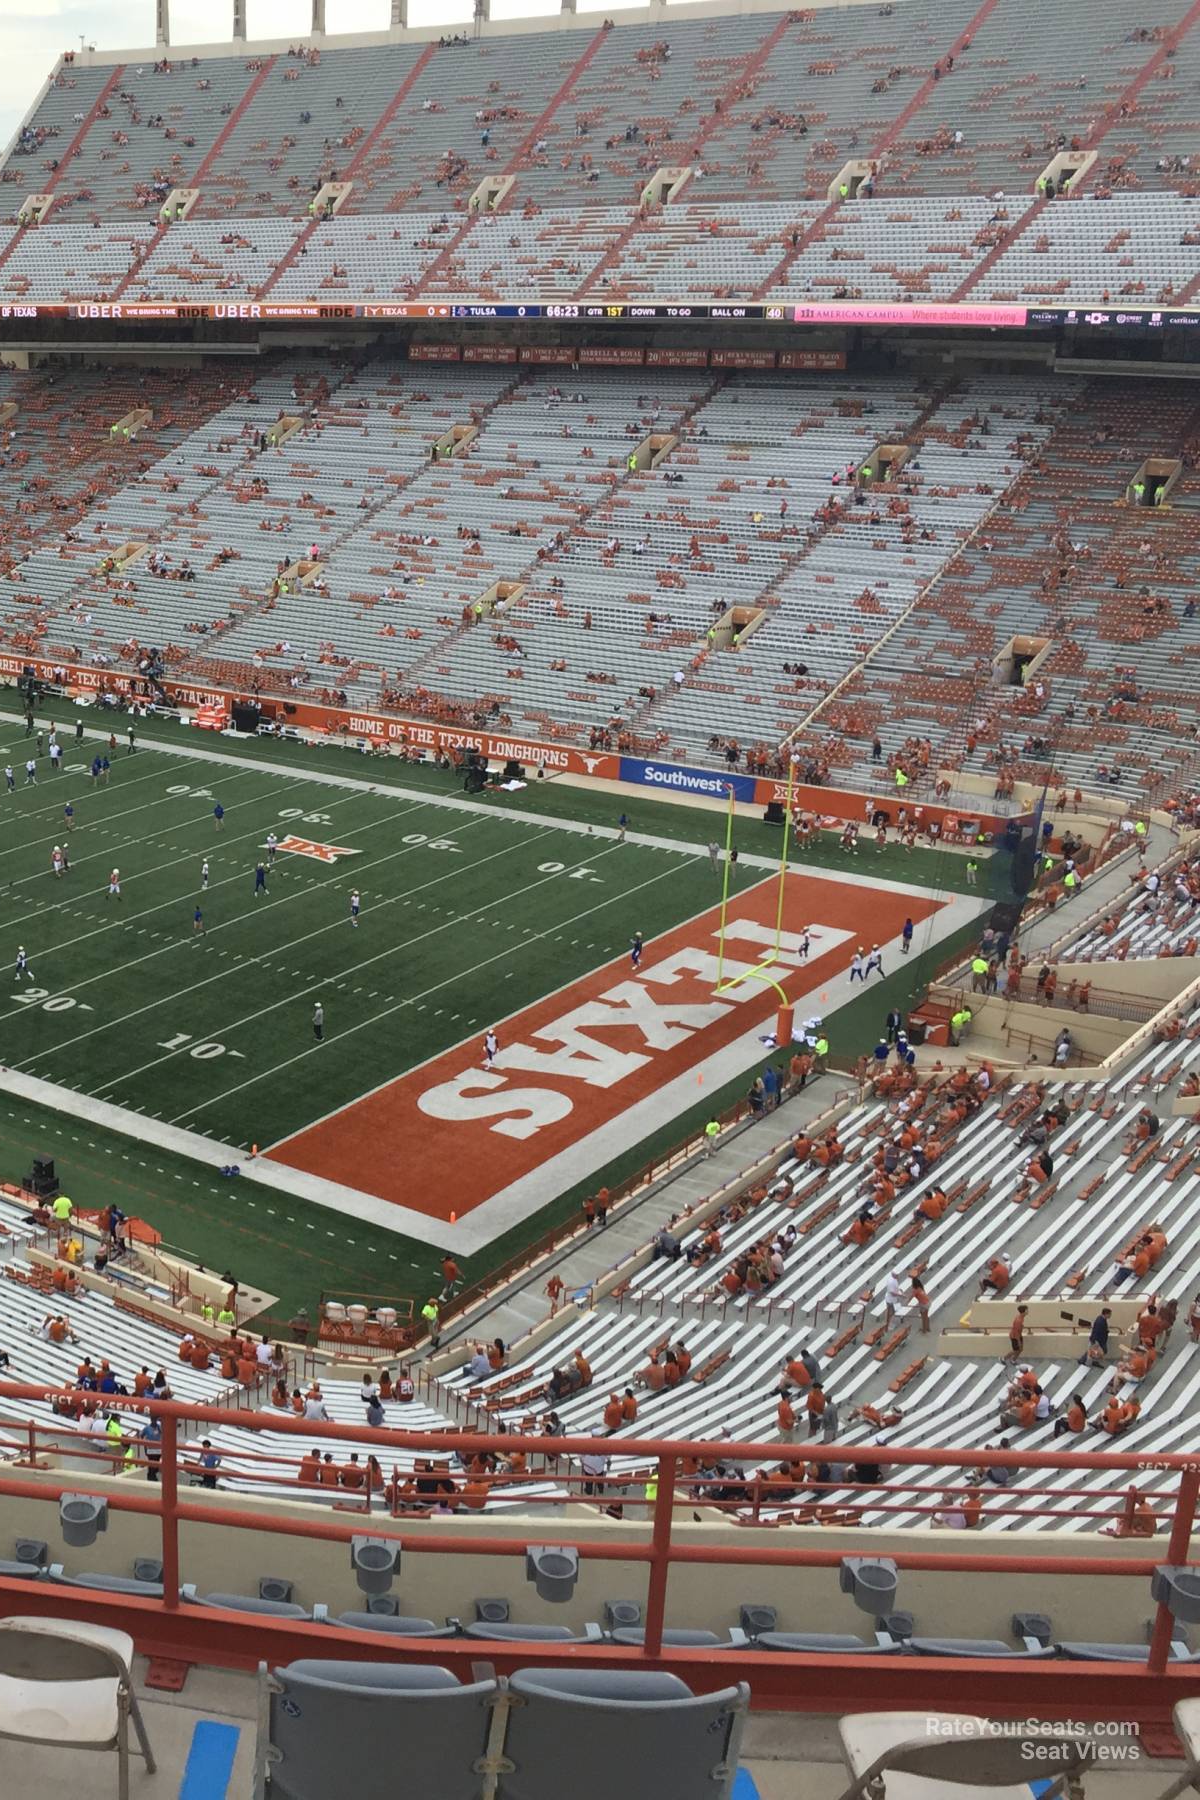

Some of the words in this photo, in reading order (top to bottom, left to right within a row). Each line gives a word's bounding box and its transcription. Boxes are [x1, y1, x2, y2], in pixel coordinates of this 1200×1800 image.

[2, 307, 11, 317] OF
[13, 307, 37, 317] TEXAS
[77, 305, 122, 318] UBER
[177, 308, 209, 317] RIDE
[215, 305, 261, 318] UBER
[319, 308, 352, 317] RIDE
[428, 307, 435, 315] 0
[518, 307, 525, 316] 0
[546, 306, 579, 316] 66:23
[587, 308, 603, 316] QTR
[606, 307, 623, 316] 1ST
[712, 308, 731, 316] BALL
[767, 308, 780, 317] 40
[816, 310, 864, 319] AMERICAN
[866, 310, 904, 319] CAMPUS
[912, 309, 937, 319] Where
[939, 309, 973, 320] students
[648, 352, 658, 361] 20
[781, 354, 791, 364] 12
[349, 717, 385, 736] HOME
[388, 724, 403, 741] OF
[408, 726, 435, 745] THE
[438, 731, 483, 750] TEXAS
[487, 739, 569, 767] LONGHORNS
[644, 766, 723, 792] Southwest
[165, 783, 212, 800] 40
[277, 807, 329, 825] 30
[400, 833, 460, 851] 20
[536, 861, 598, 881] 10
[10, 987, 78, 1012] 20
[417, 918, 858, 1140] TEXAS
[156, 1032, 227, 1059] 10
[400, 1382, 413, 1393] 20
[43, 1392, 73, 1405] SECT
[81, 1398, 139, 1414] 12/SEAT
[1137, 1461, 1171, 1471] SECT
